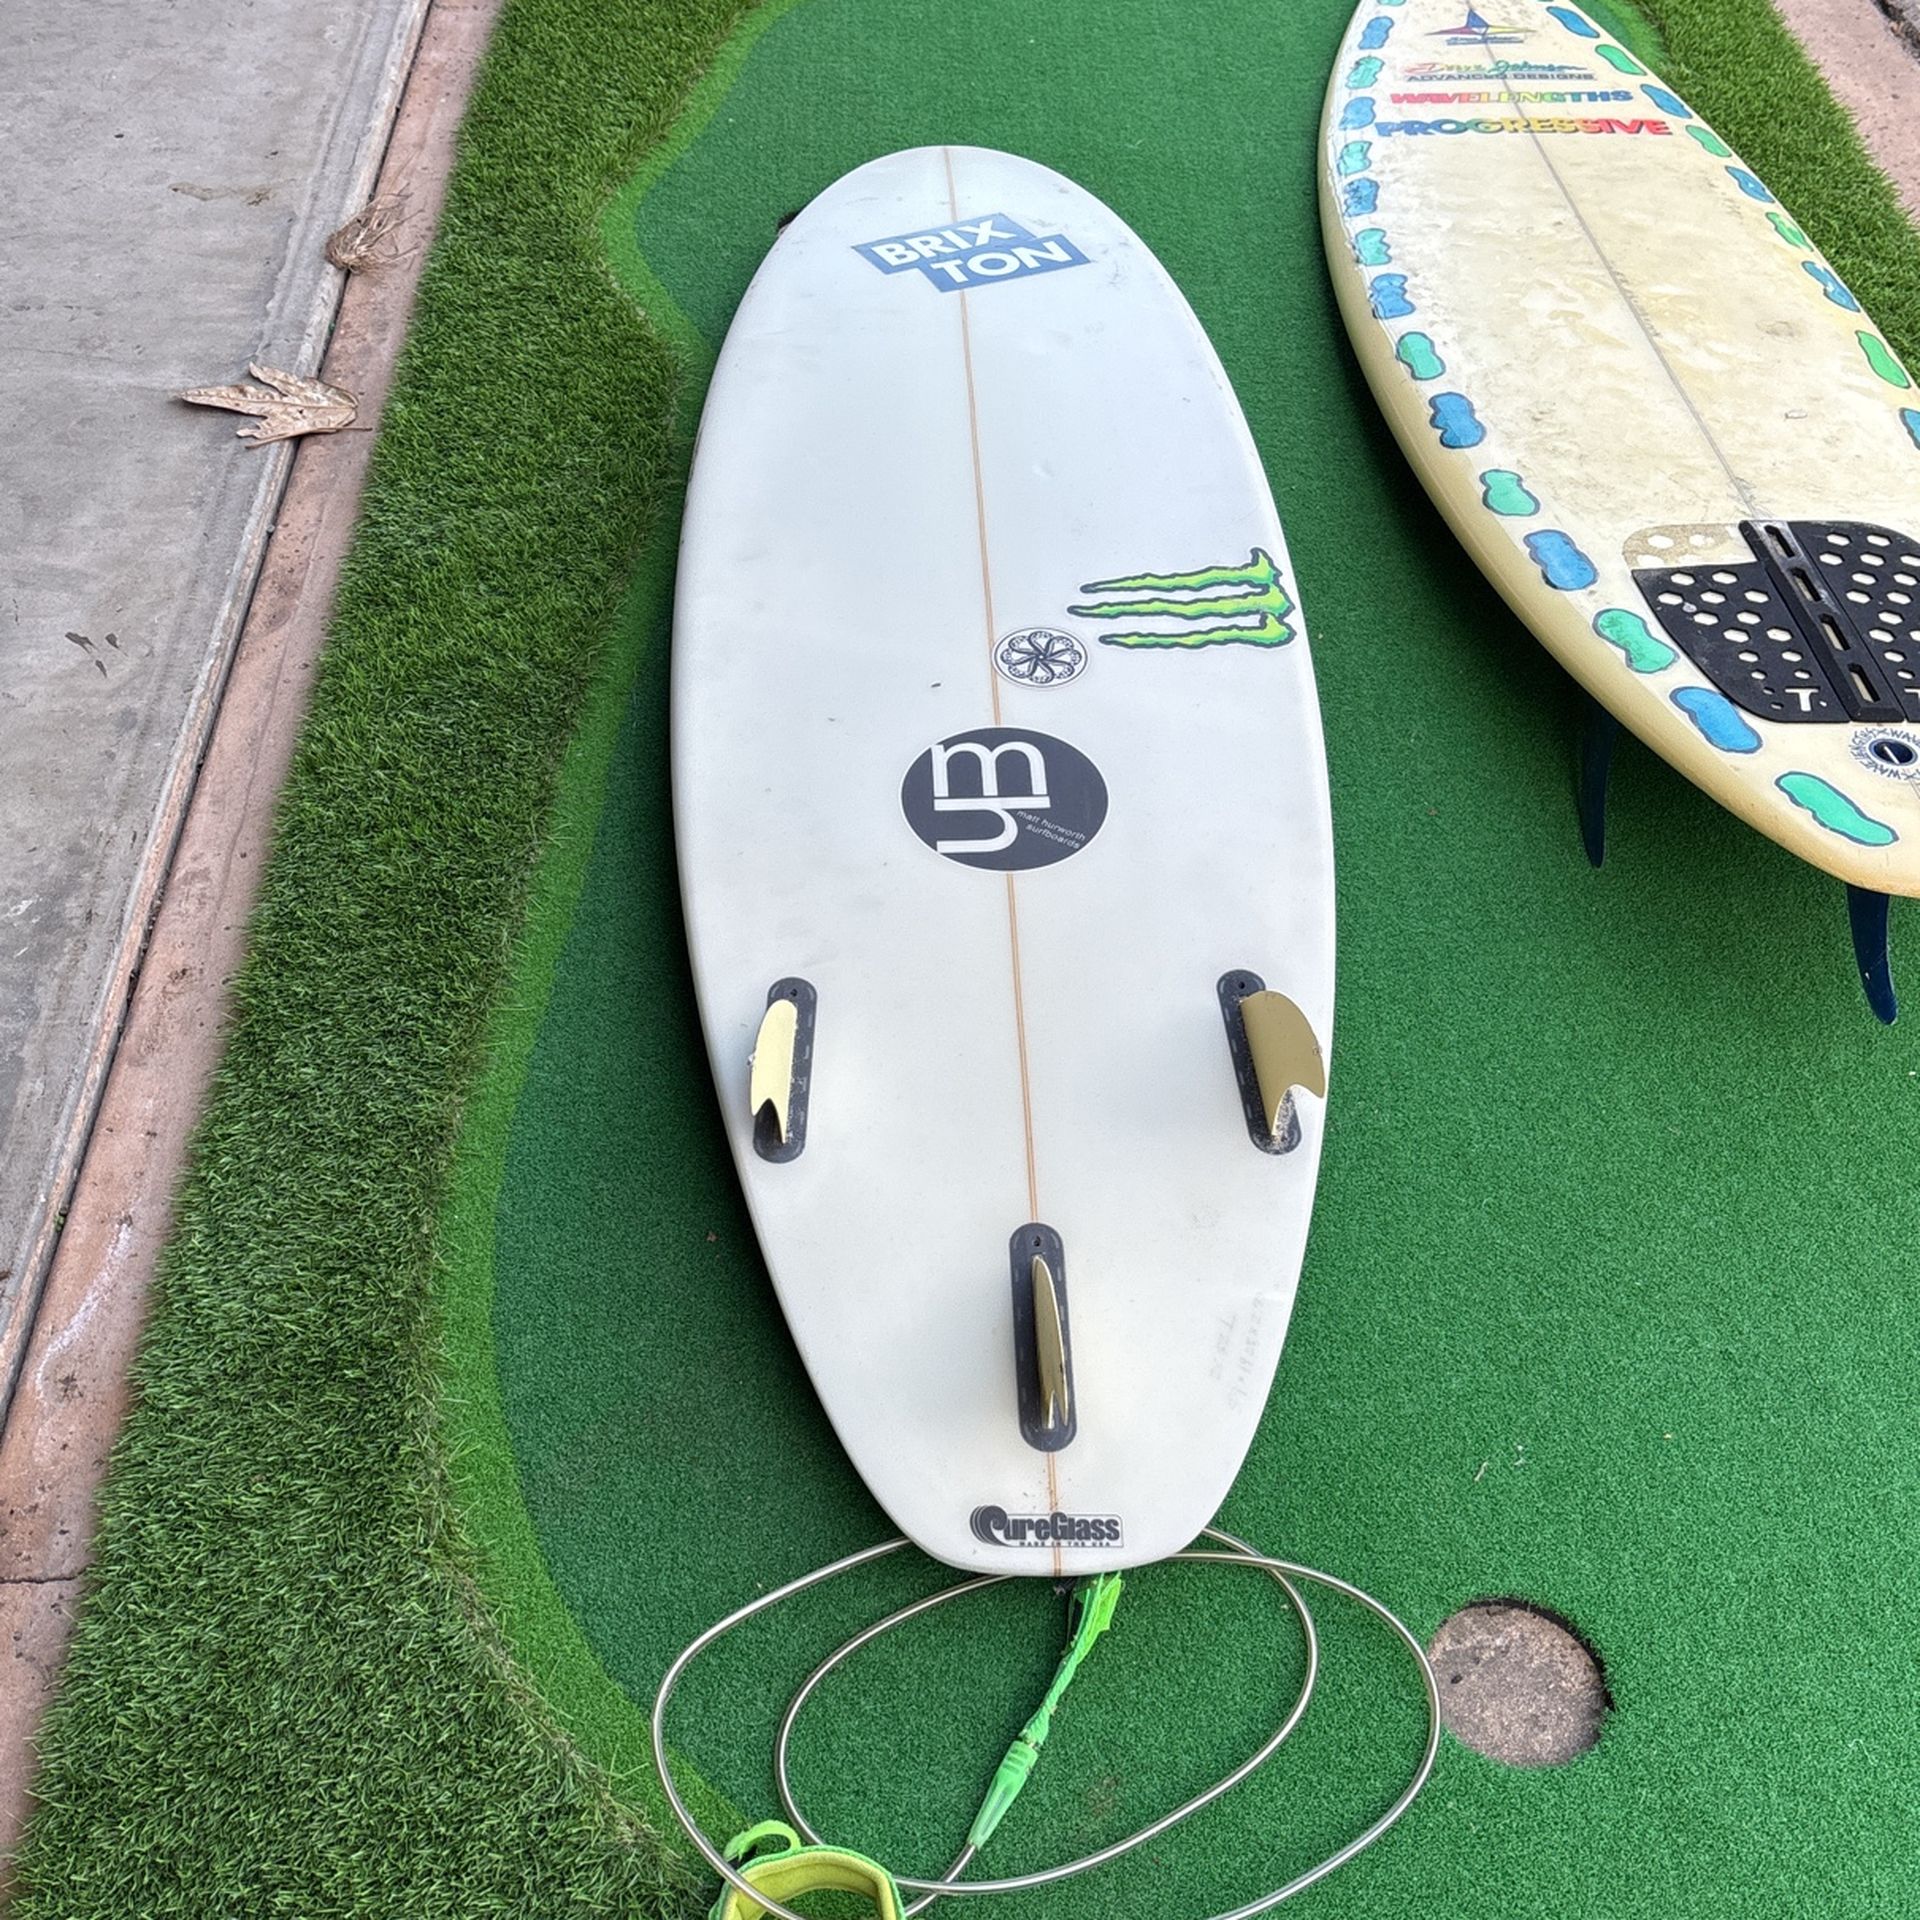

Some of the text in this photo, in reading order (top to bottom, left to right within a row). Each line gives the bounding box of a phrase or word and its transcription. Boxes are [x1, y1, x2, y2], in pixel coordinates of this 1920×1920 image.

[1516, 72, 1596, 81] DESIGNS
[1389, 89, 1635, 104] WAVELENGTHS
[1374, 117, 1674, 137] PROGRESSIVE
[870, 219, 1017, 268] BRIX
[930, 240, 1074, 284] TON
[1016, 810, 1086, 841] matt hurworth
[1025, 823, 1081, 849] surfboards
